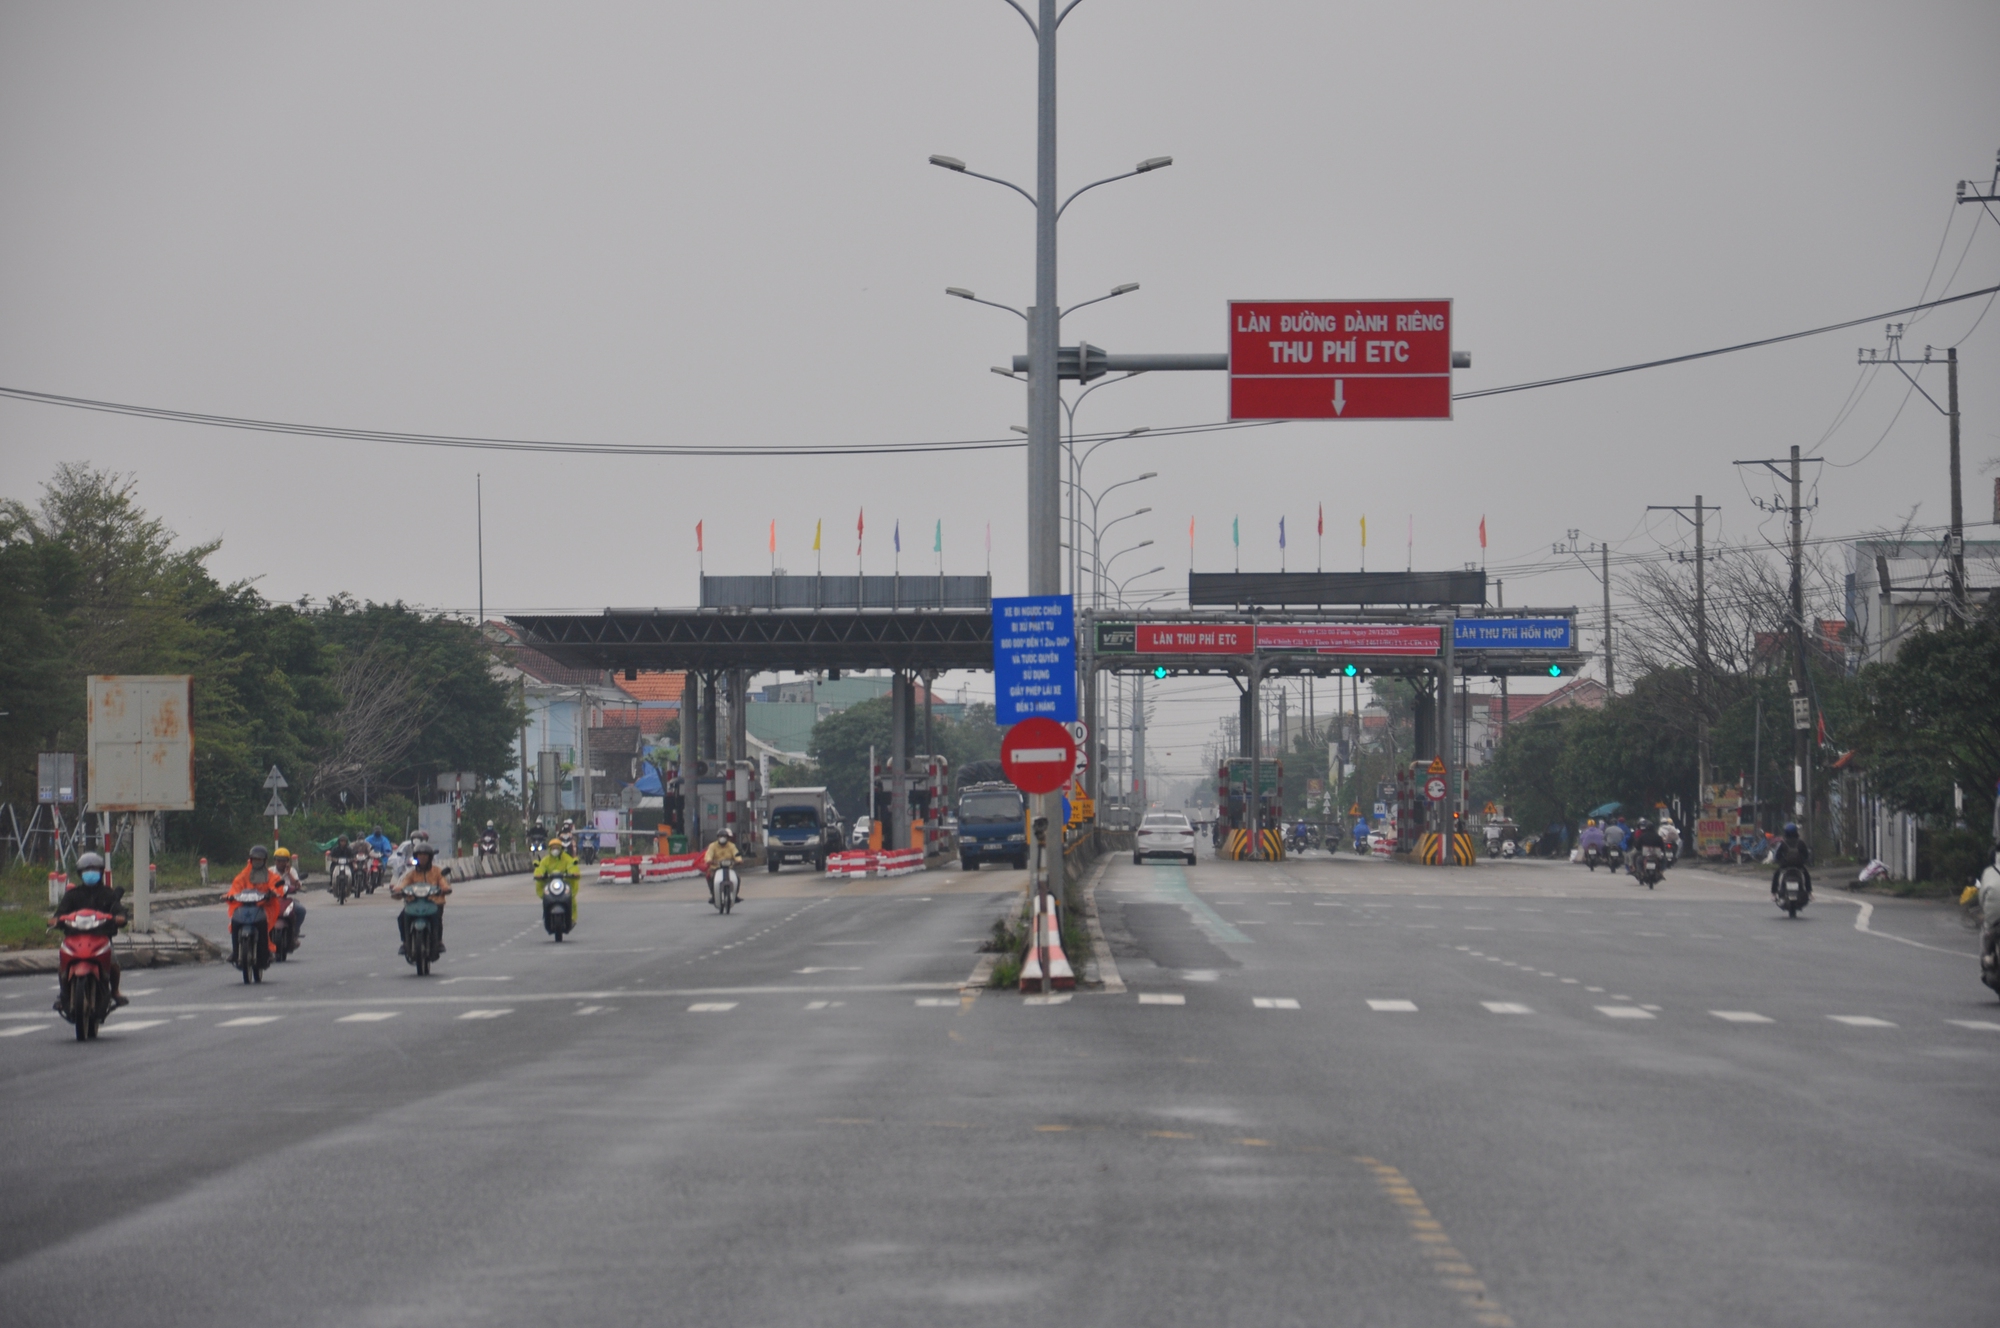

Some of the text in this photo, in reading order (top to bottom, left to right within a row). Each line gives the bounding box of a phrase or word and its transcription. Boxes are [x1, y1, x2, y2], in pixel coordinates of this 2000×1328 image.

[1237, 310, 1444, 332] LÀN ĐƯỜNG DÀNH RIÊNG
[1269, 336, 1409, 363] THU PHÍ ETC
[1004, 606, 1012, 617] XE
[1103, 631, 1134, 646] VETC
[1153, 631, 1237, 645] LÀN THU PHÍ ETC
[1455, 625, 1476, 639] LÀN
[1479, 627, 1499, 639] THU
[1502, 626, 1518, 639] PHÍ
[1012, 652, 1020, 664] VÀ
[1053, 684, 1061, 696] XE
